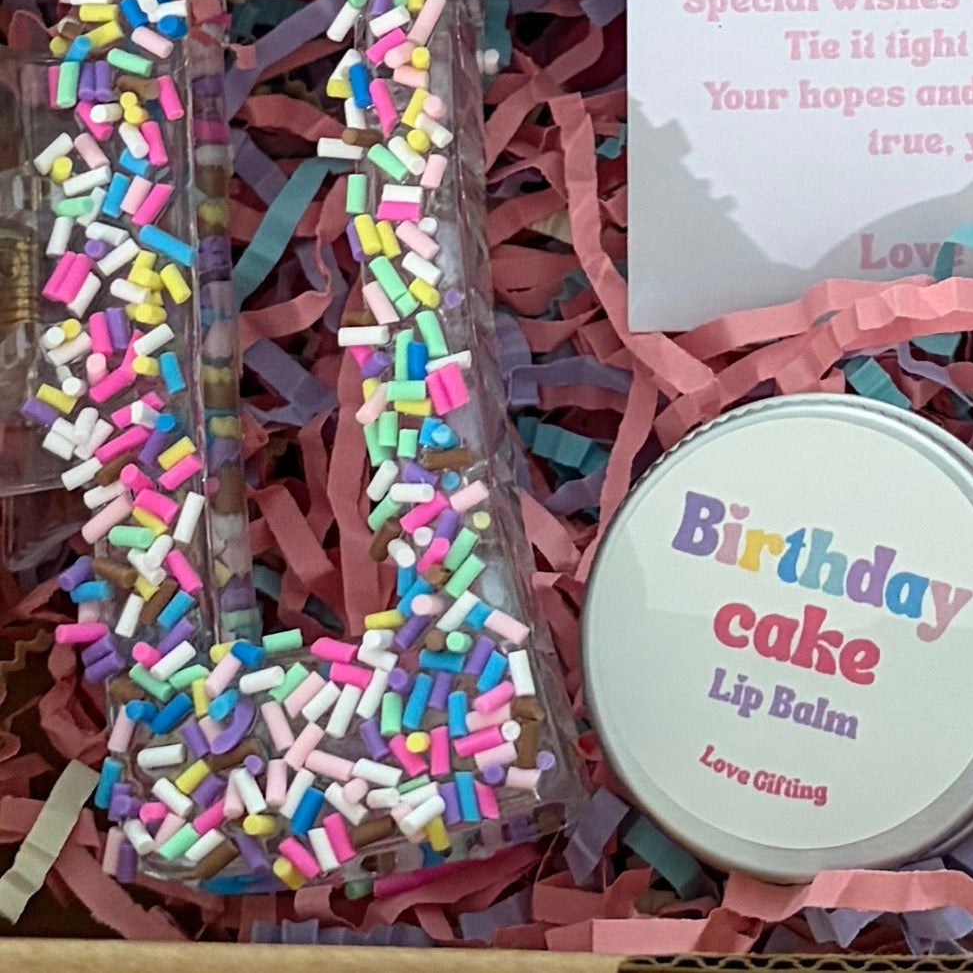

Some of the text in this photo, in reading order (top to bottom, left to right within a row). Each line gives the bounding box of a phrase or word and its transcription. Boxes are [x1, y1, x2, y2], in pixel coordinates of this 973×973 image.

[784, 29, 841, 63] Tie
[850, 29, 875, 60] it
[885, 27, 968, 68] tight
[704, 80, 788, 112] Your
[797, 79, 906, 119] hopes
[671, 491, 973, 643] Birthday
[713, 602, 882, 685] cake
[709, 668, 859, 740] Lip Balm
[699, 745, 827, 806] Love Gifting
